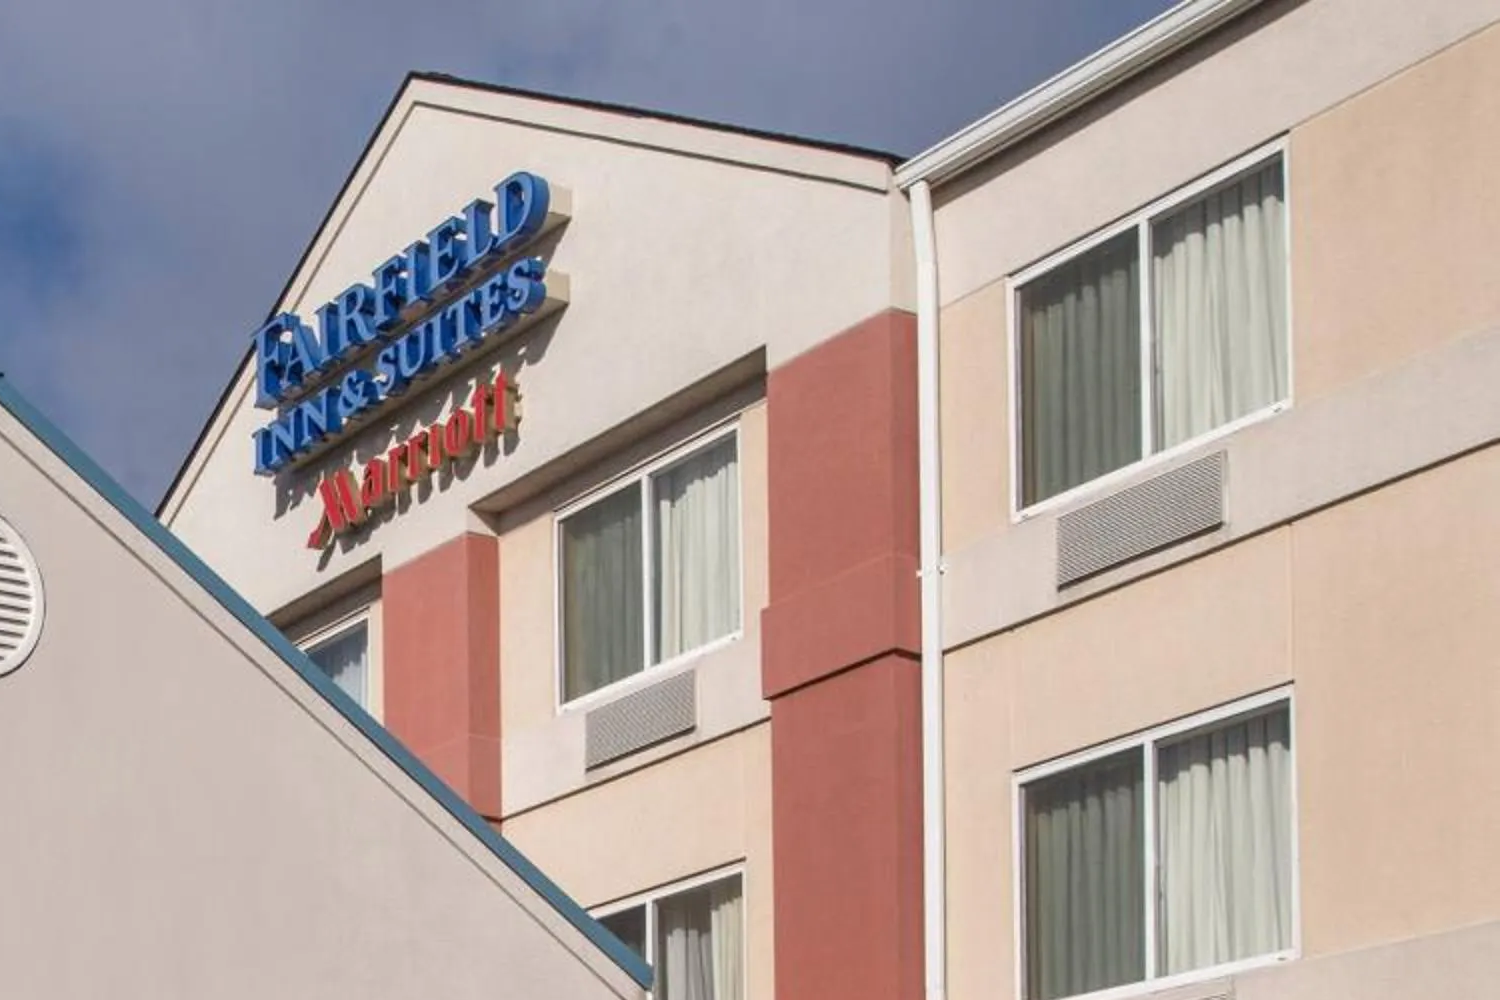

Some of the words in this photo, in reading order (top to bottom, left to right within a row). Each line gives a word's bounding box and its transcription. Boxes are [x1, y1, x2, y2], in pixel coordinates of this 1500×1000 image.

[252, 171, 551, 411] FAIRFIELD
[252, 384, 344, 477] INN
[376, 256, 548, 402] SUITES
[306, 368, 518, 550] Marriott
